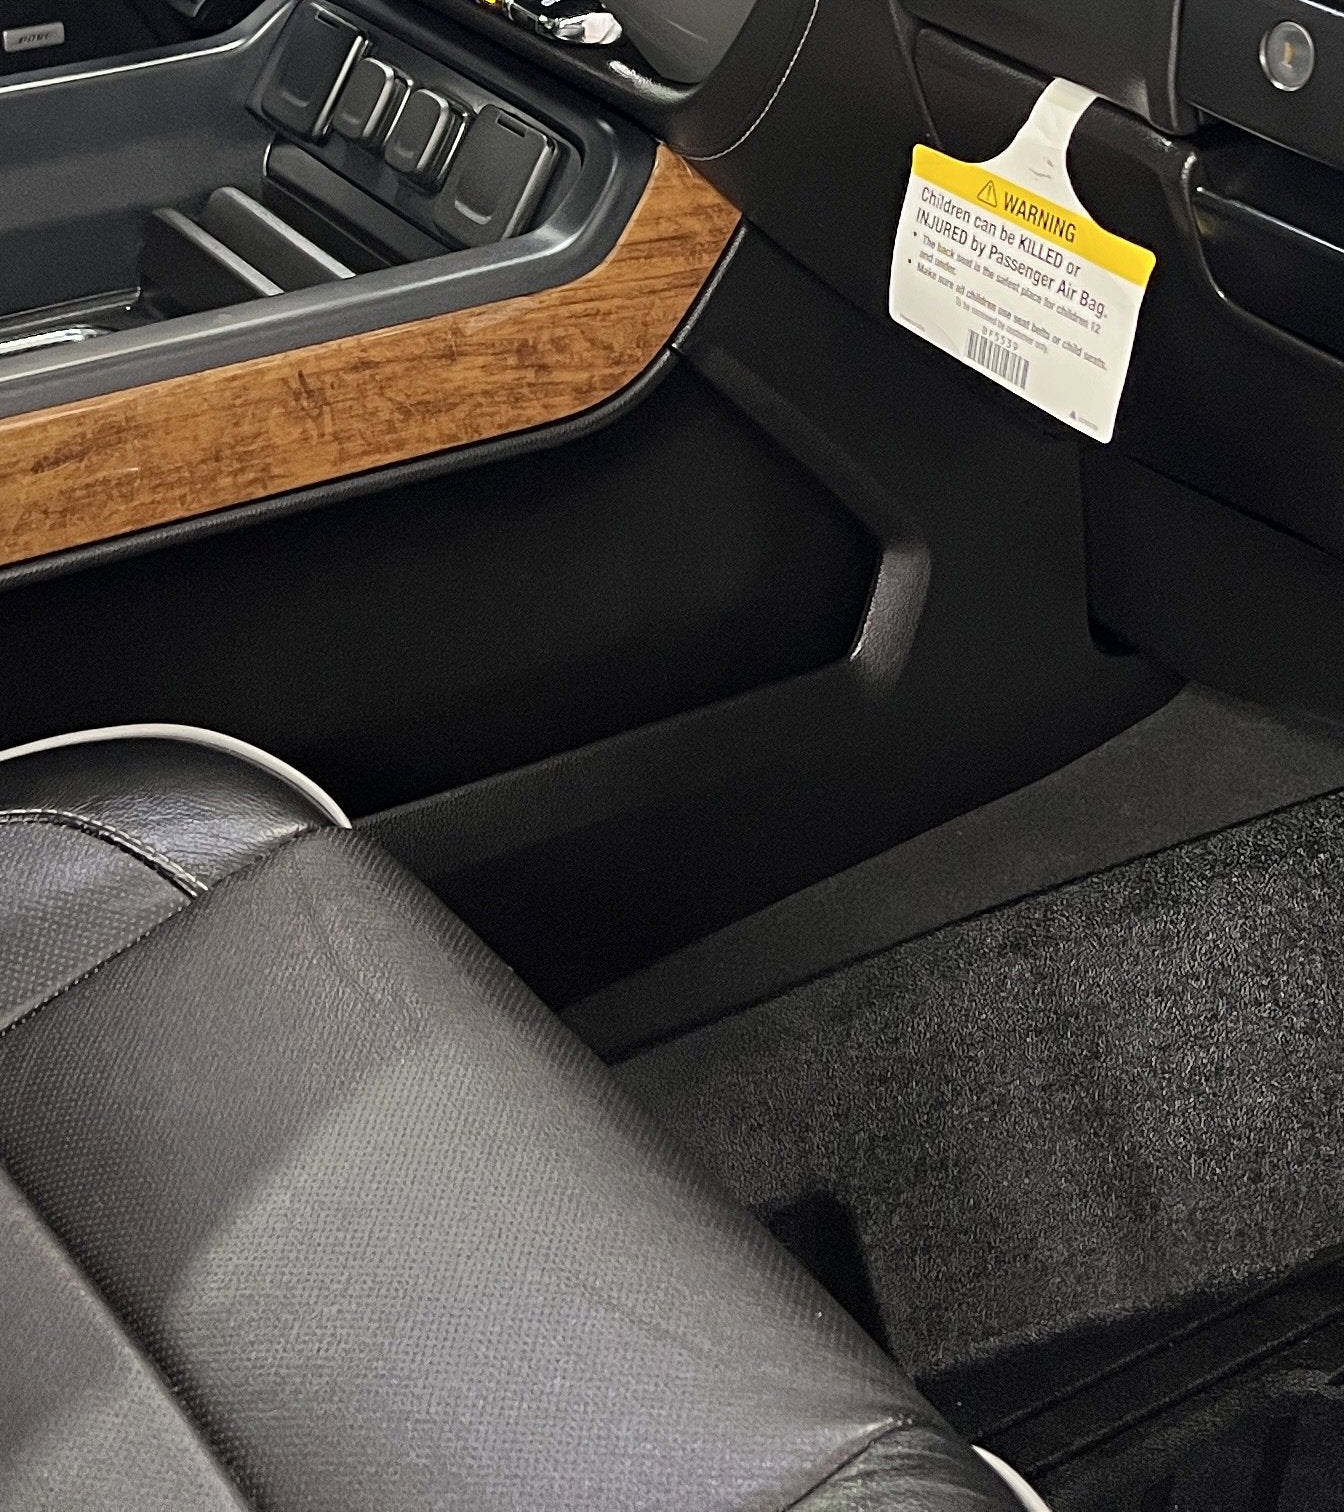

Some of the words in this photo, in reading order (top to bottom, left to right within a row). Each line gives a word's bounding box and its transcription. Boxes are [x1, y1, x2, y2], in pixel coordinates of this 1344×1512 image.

[921, 186, 970, 223] Children
[973, 215, 997, 236] can
[999, 225, 1016, 245] be
[1018, 234, 1064, 269] KILLED
[1066, 262, 1081, 277] or
[1004, 191, 1076, 243] WARNING
[916, 207, 968, 245] INJURED
[970, 235, 987, 257] by
[988, 245, 1055, 289] Passenger
[1056, 280, 1078, 301] Air
[1080, 290, 1108, 319] Bag.
